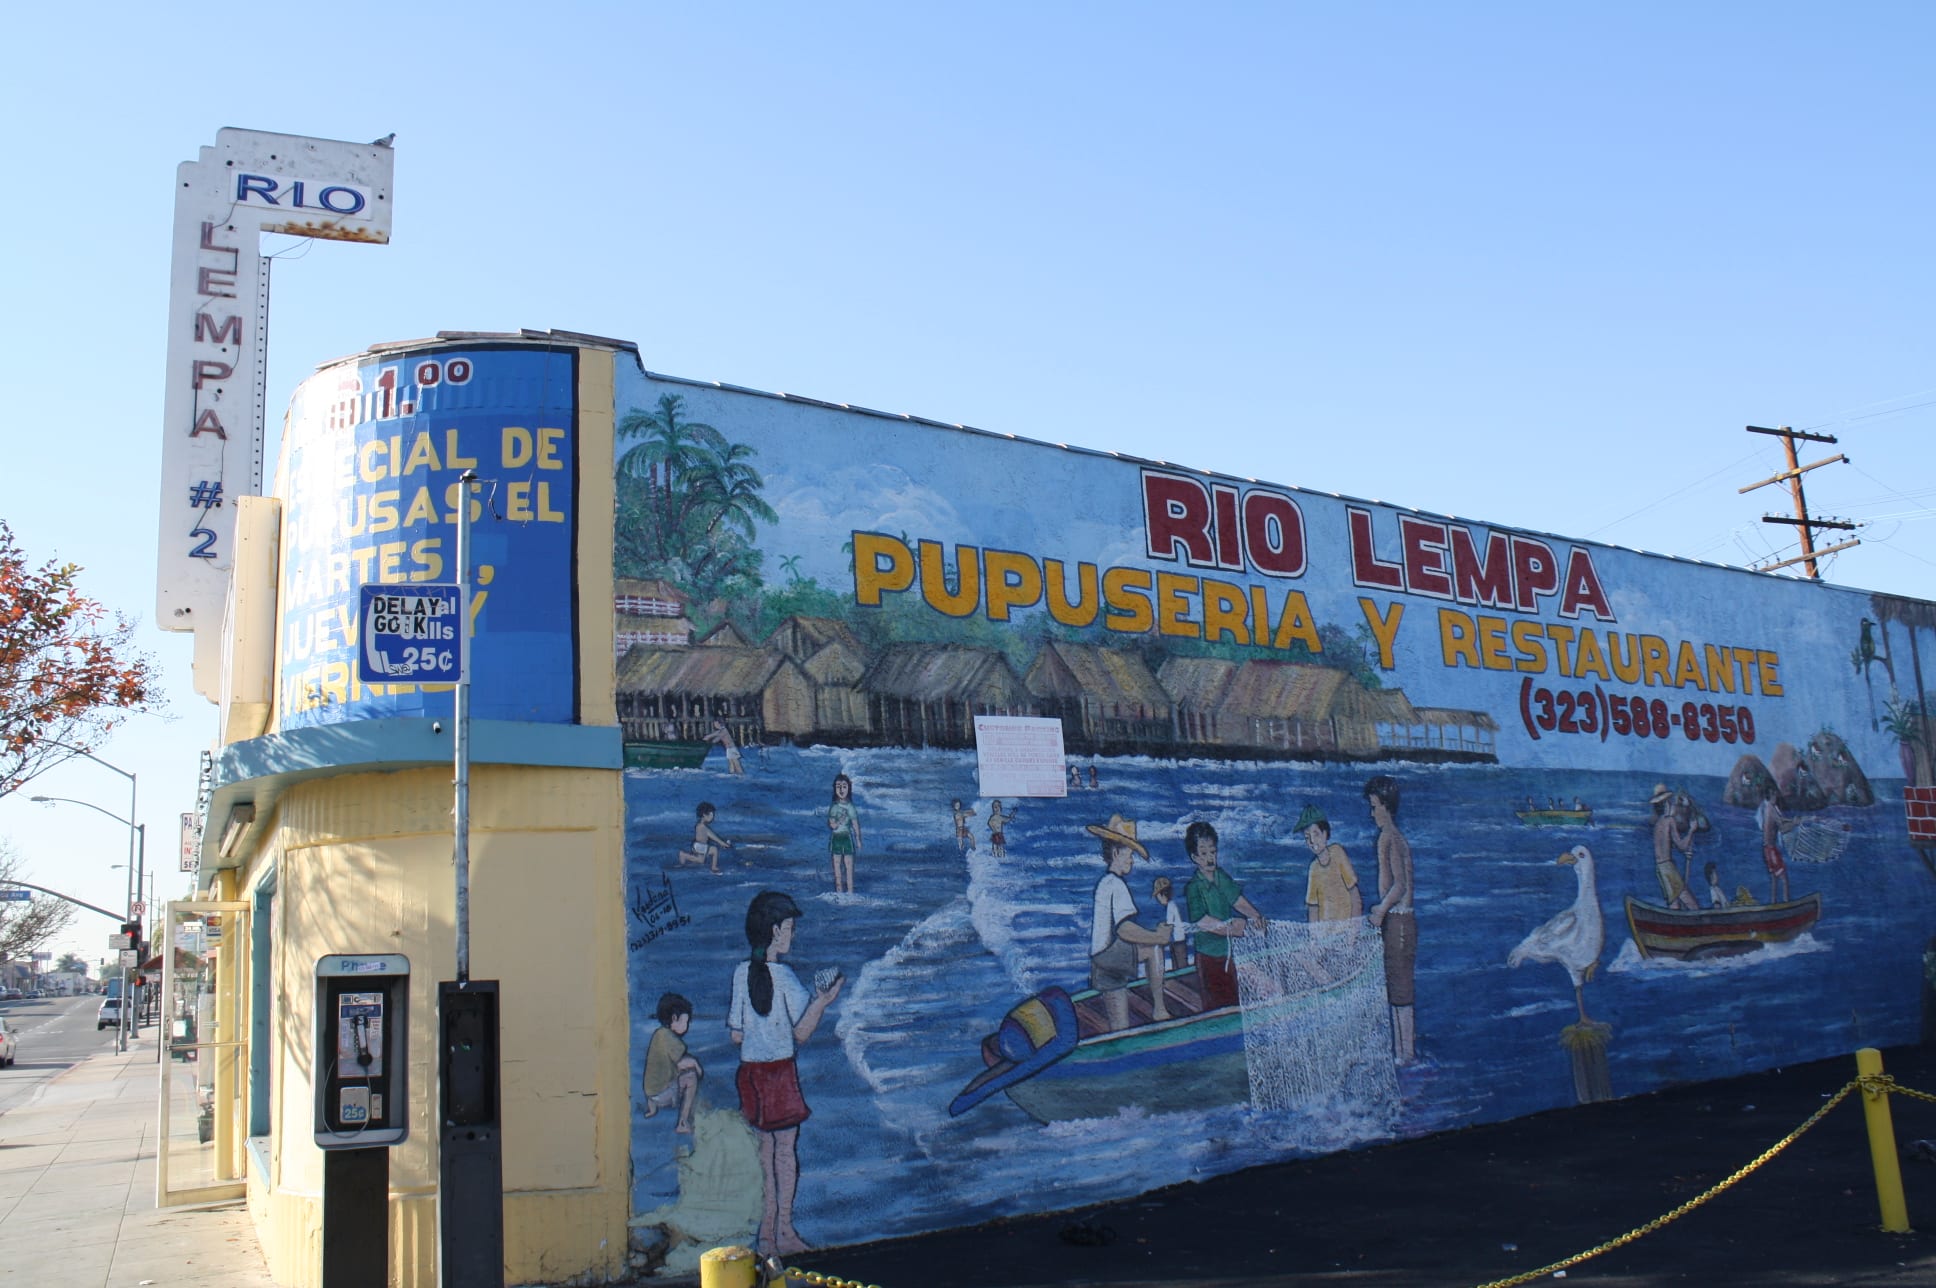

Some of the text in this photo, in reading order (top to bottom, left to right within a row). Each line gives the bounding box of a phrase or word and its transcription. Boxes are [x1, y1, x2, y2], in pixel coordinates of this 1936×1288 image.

[237, 174, 366, 215] RIO
[189, 221, 243, 440] LEMPA
[502, 427, 565, 470] DE
[507, 481, 565, 522] EL
[1140, 467, 1617, 623] RIO LEMPA
[374, 597, 441, 615] DELAY
[851, 529, 1785, 697] PUPUSERIA Y RESTAURANTE
[403, 647, 453, 672] 25¢
[1519, 676, 1757, 745] (323)588-8350
